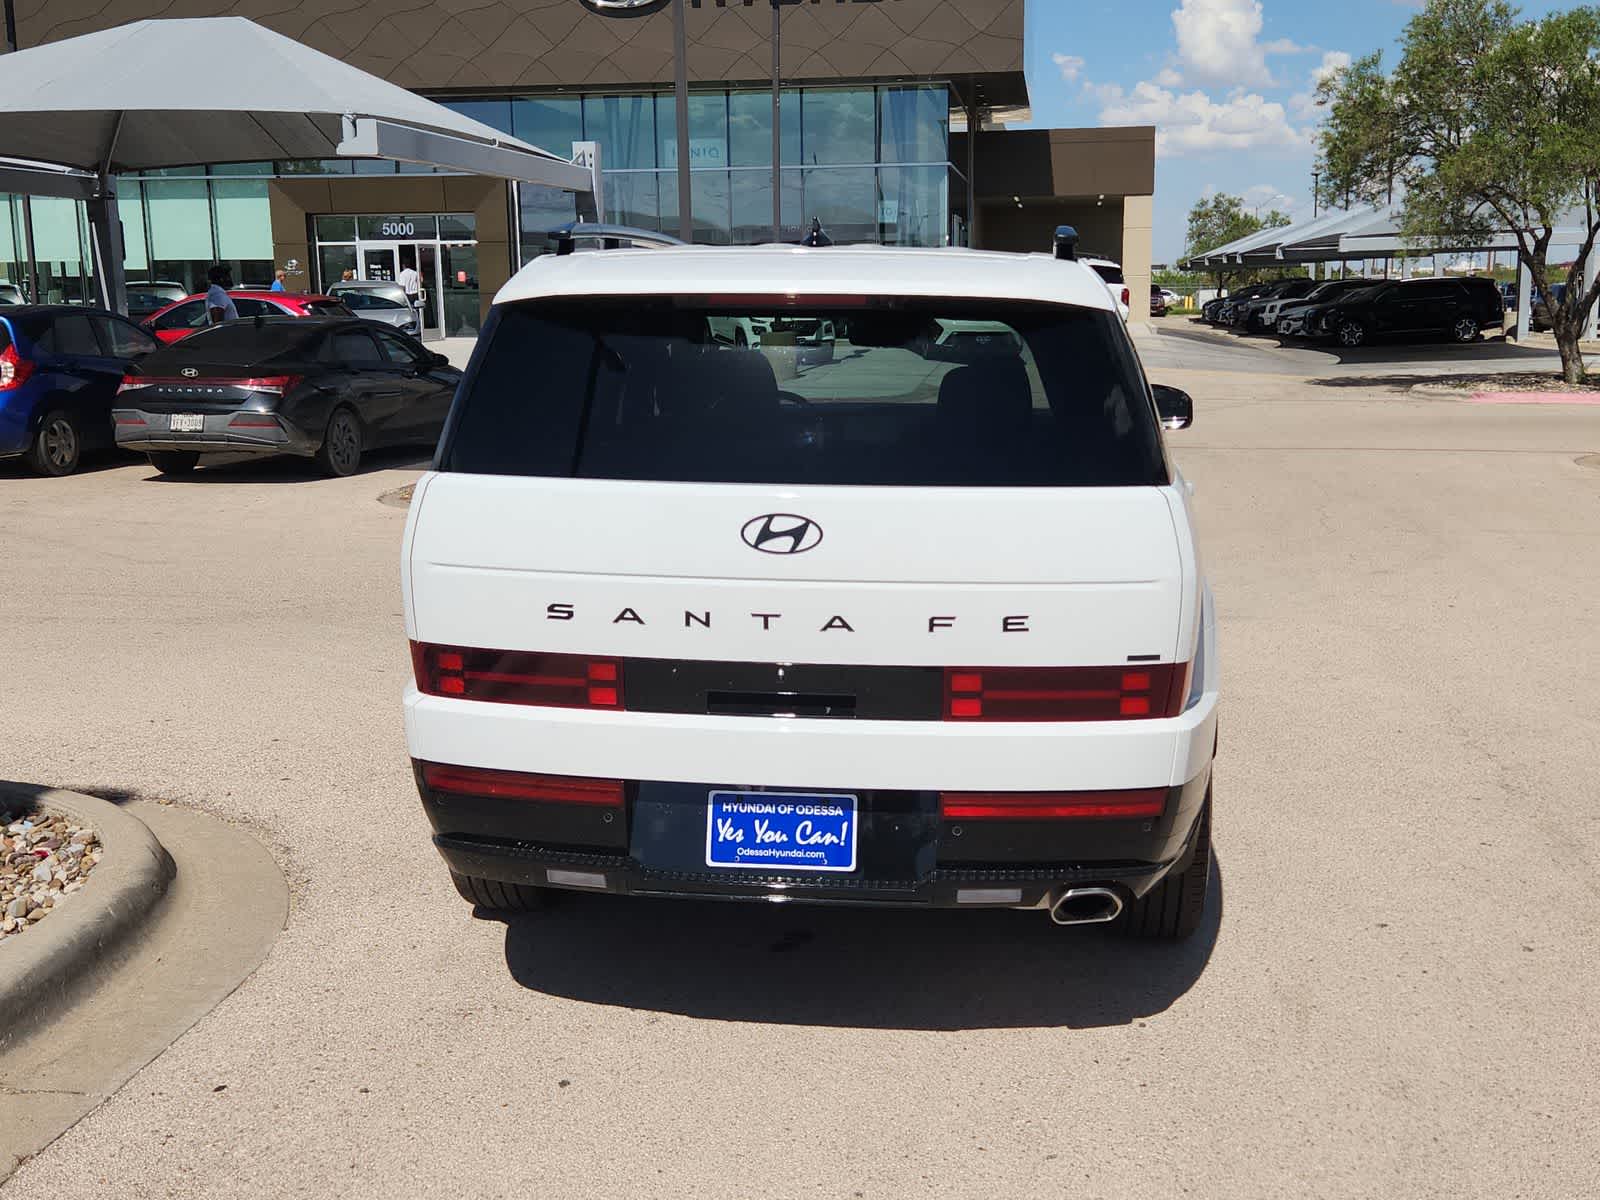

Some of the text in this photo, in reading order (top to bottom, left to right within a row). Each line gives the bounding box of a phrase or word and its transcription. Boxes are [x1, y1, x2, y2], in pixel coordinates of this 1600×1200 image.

[382, 222, 415, 236] 5000
[546, 603, 1030, 633] SANTA FE
[722, 802, 843, 816] HYUNDAI OF ODESSA
[716, 818, 849, 846] Yes You Can!
[737, 847, 825, 859] OdessaHyundai.com
